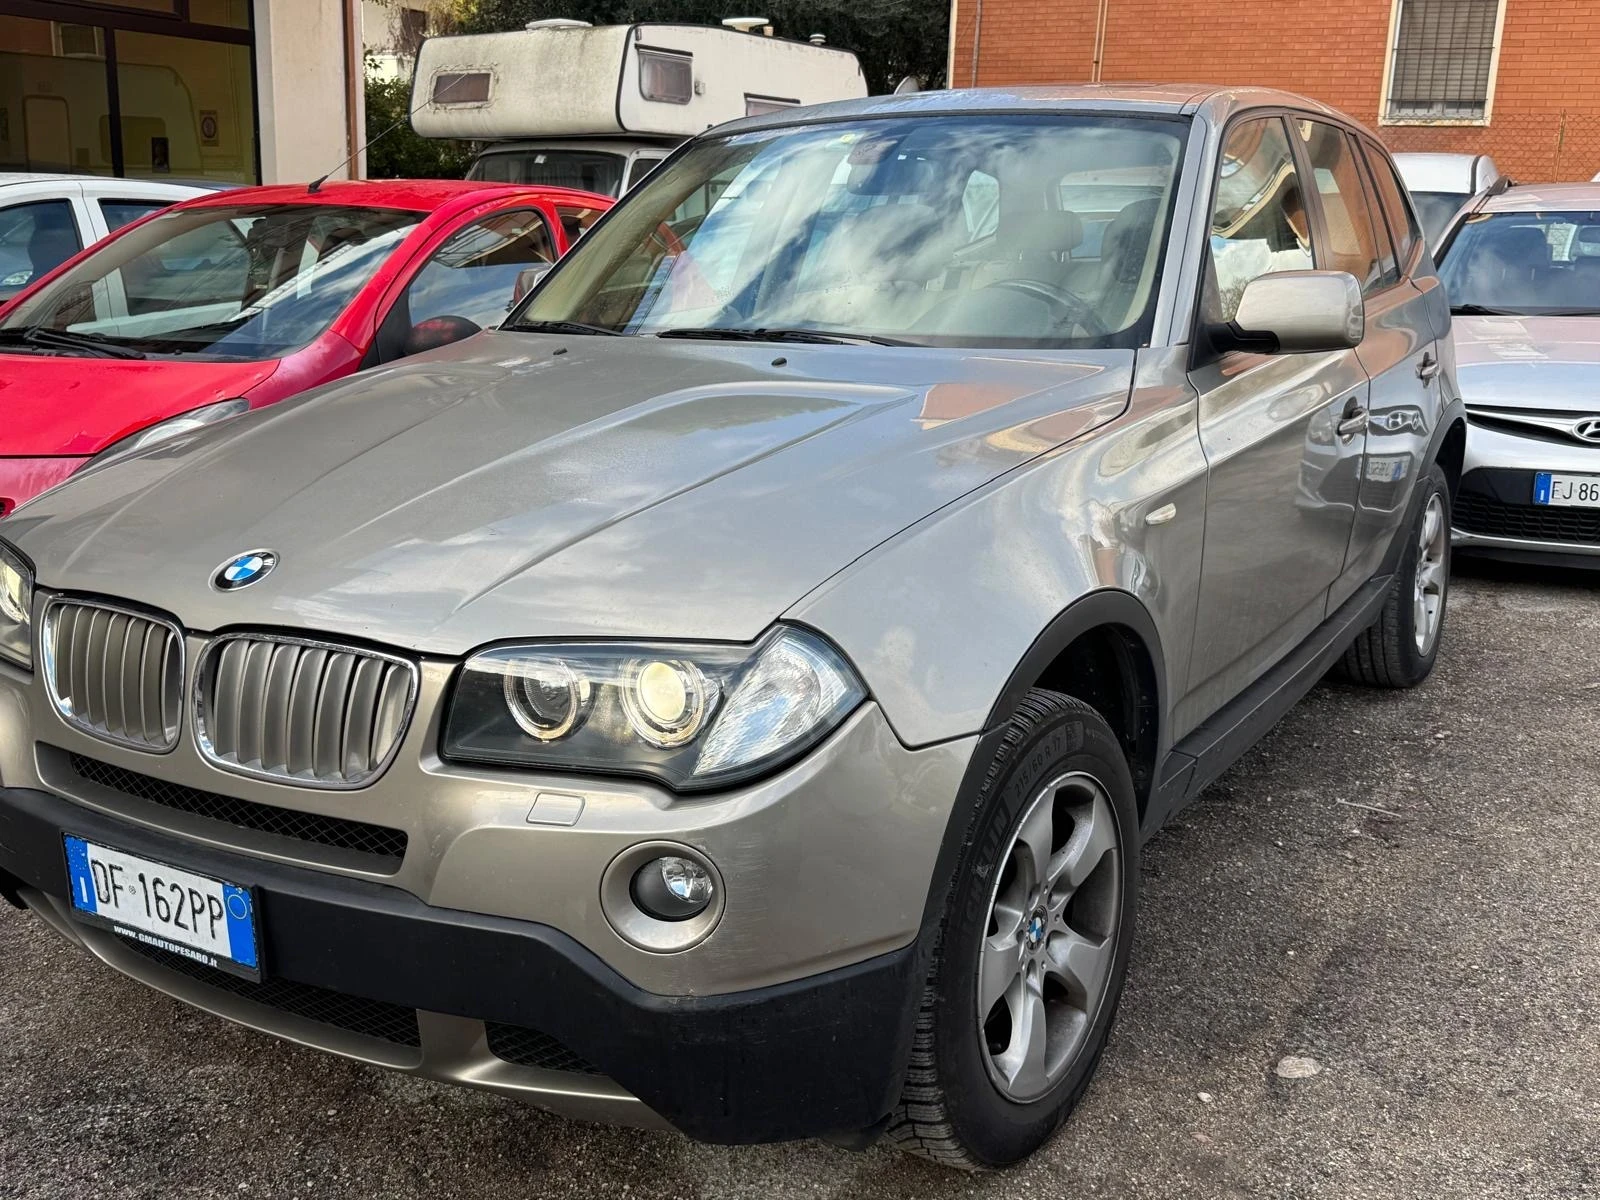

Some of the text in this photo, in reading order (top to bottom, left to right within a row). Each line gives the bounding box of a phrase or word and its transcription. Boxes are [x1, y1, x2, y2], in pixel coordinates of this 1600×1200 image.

[1551, 481, 1599, 502] EJ 86
[90, 858, 224, 940] DF 162PP
